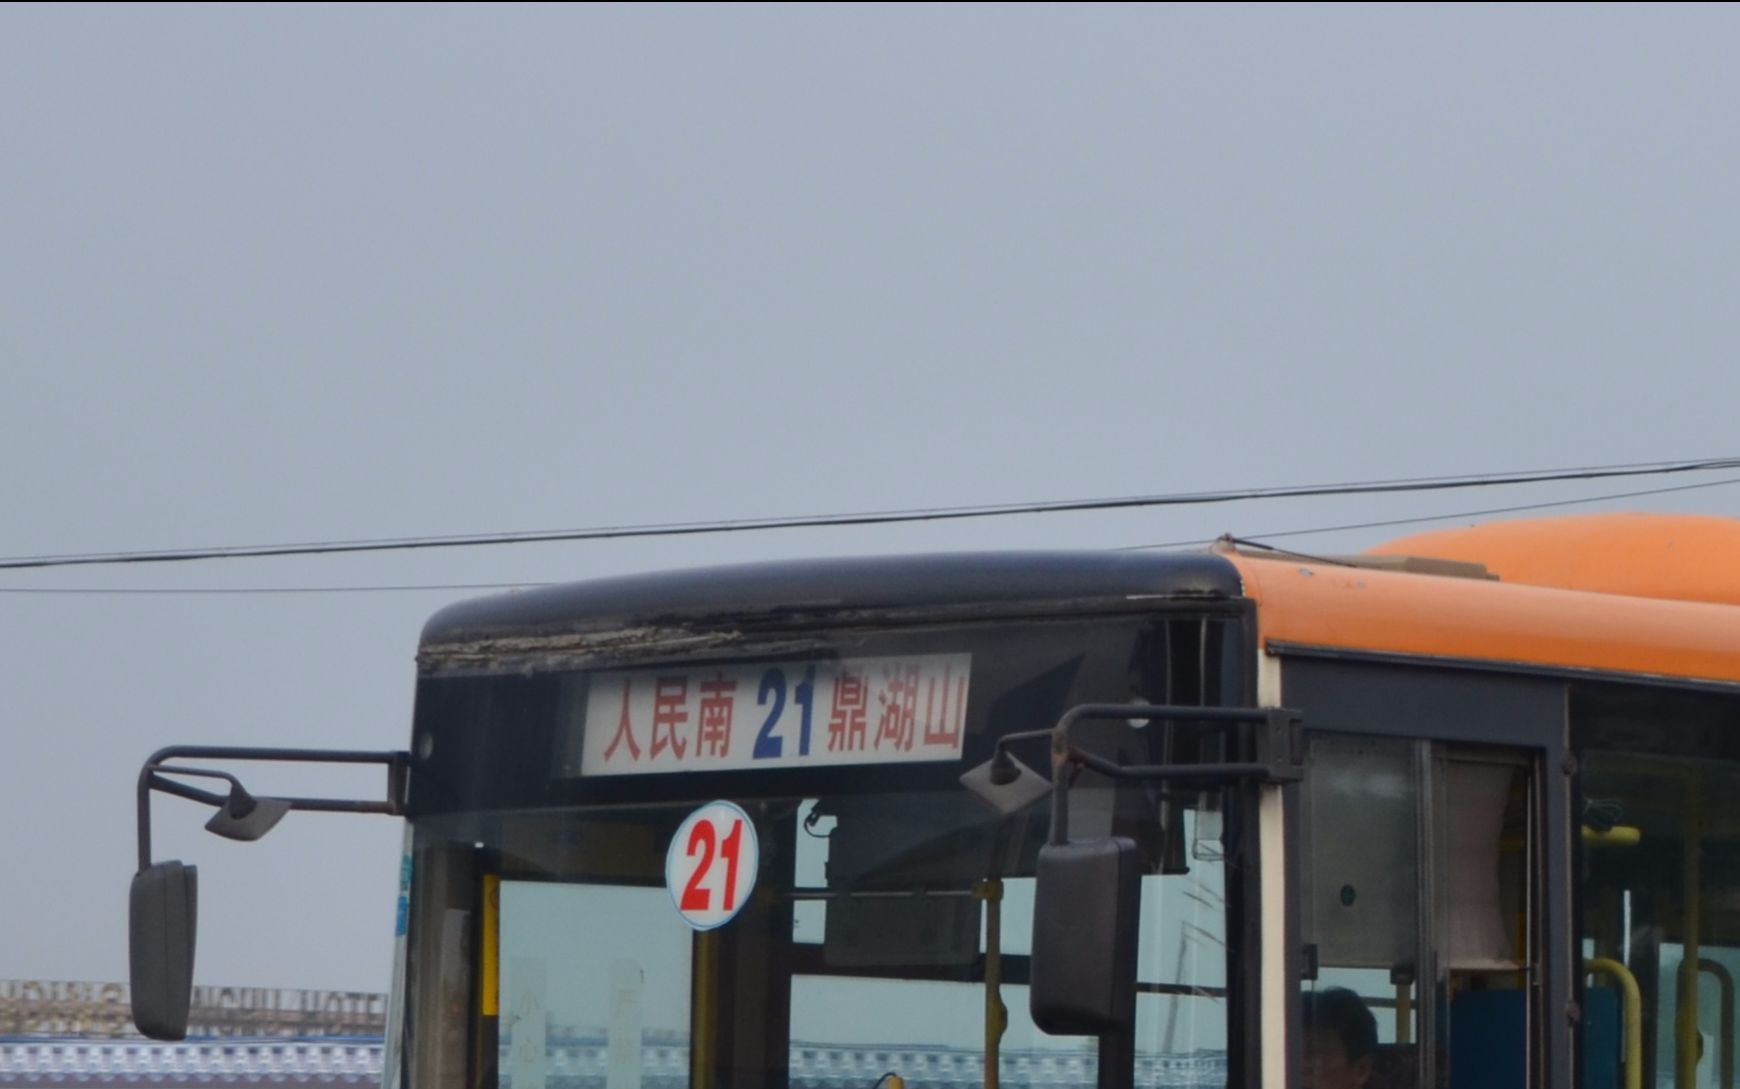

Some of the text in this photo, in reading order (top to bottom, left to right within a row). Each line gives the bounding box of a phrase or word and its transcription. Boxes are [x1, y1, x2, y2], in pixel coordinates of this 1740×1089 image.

[603, 664, 967, 761] 人民南 21 鼎湖山
[680, 818, 742, 911] 21
